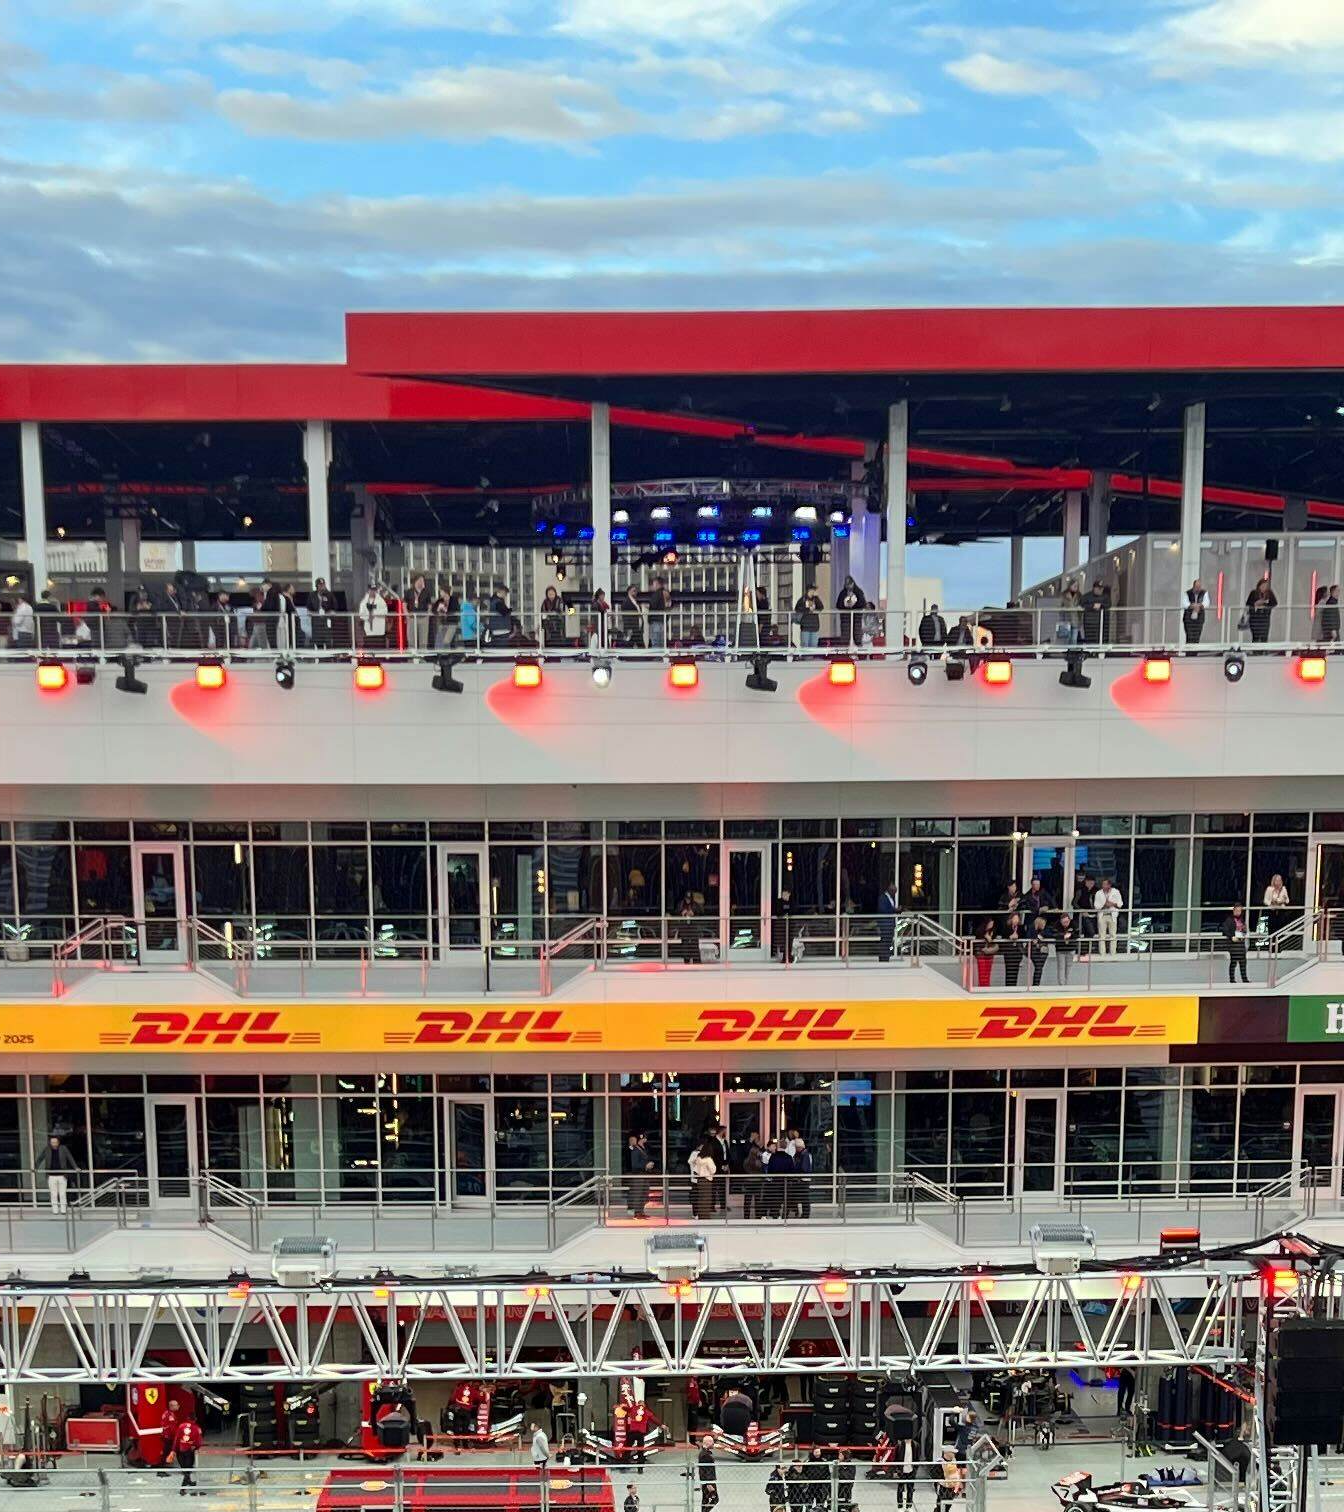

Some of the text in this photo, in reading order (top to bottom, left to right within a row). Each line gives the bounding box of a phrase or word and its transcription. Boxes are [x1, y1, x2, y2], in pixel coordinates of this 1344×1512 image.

[131, 1012, 292, 1044] DHL
[415, 1011, 574, 1043] DHL
[695, 1009, 857, 1041] DHL
[977, 1006, 1138, 1038] DHL
[4, 1035, 34, 1044] 2025
